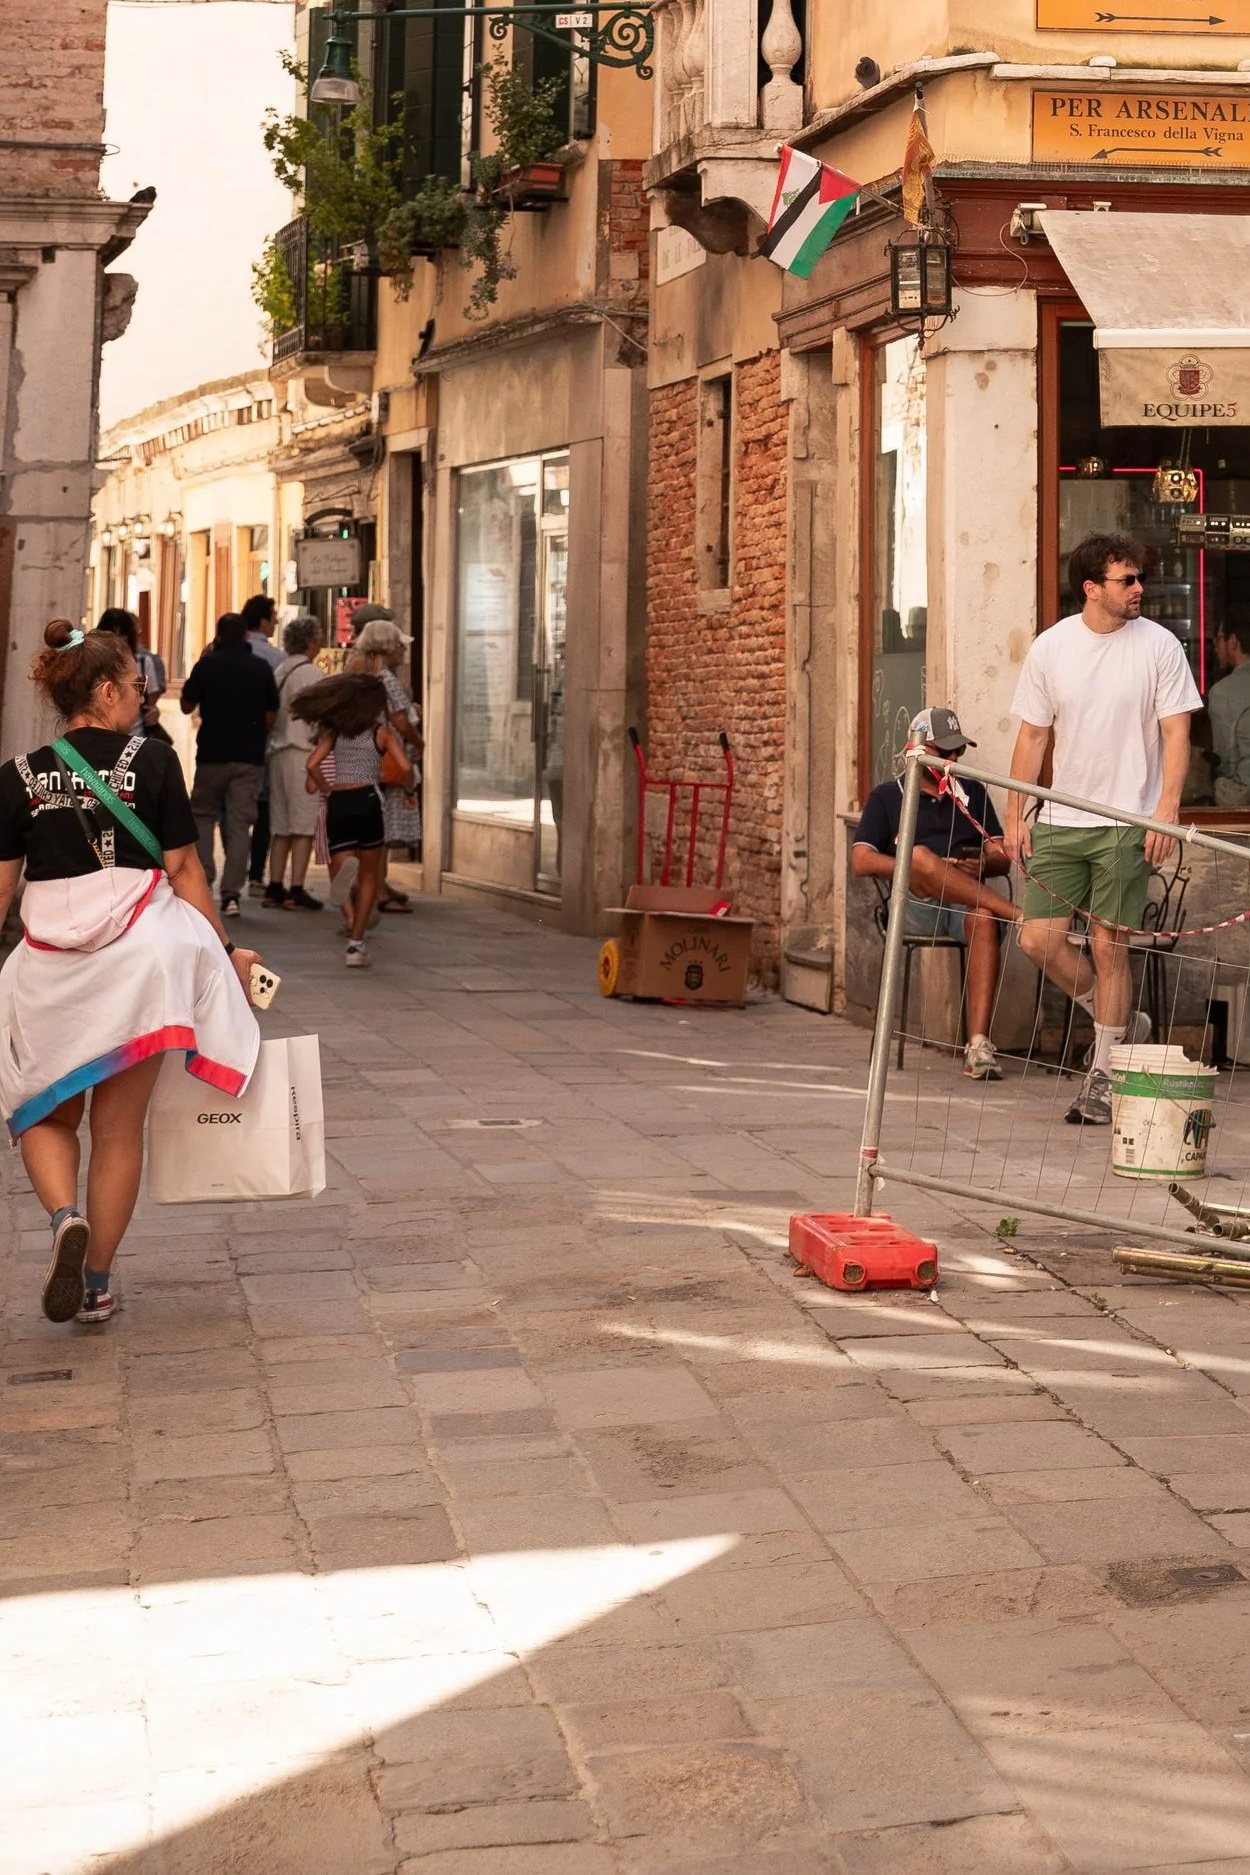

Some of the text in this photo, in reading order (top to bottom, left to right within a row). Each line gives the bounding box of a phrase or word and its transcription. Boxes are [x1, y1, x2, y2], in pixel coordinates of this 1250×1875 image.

[1051, 97, 1103, 118] PER
[1070, 123, 1244, 144] S. Francesco della Vigna
[1143, 402, 1238, 422] EQUIPE5
[659, 936, 732, 973] MOLINARI
[196, 1112, 243, 1125] GEOX
